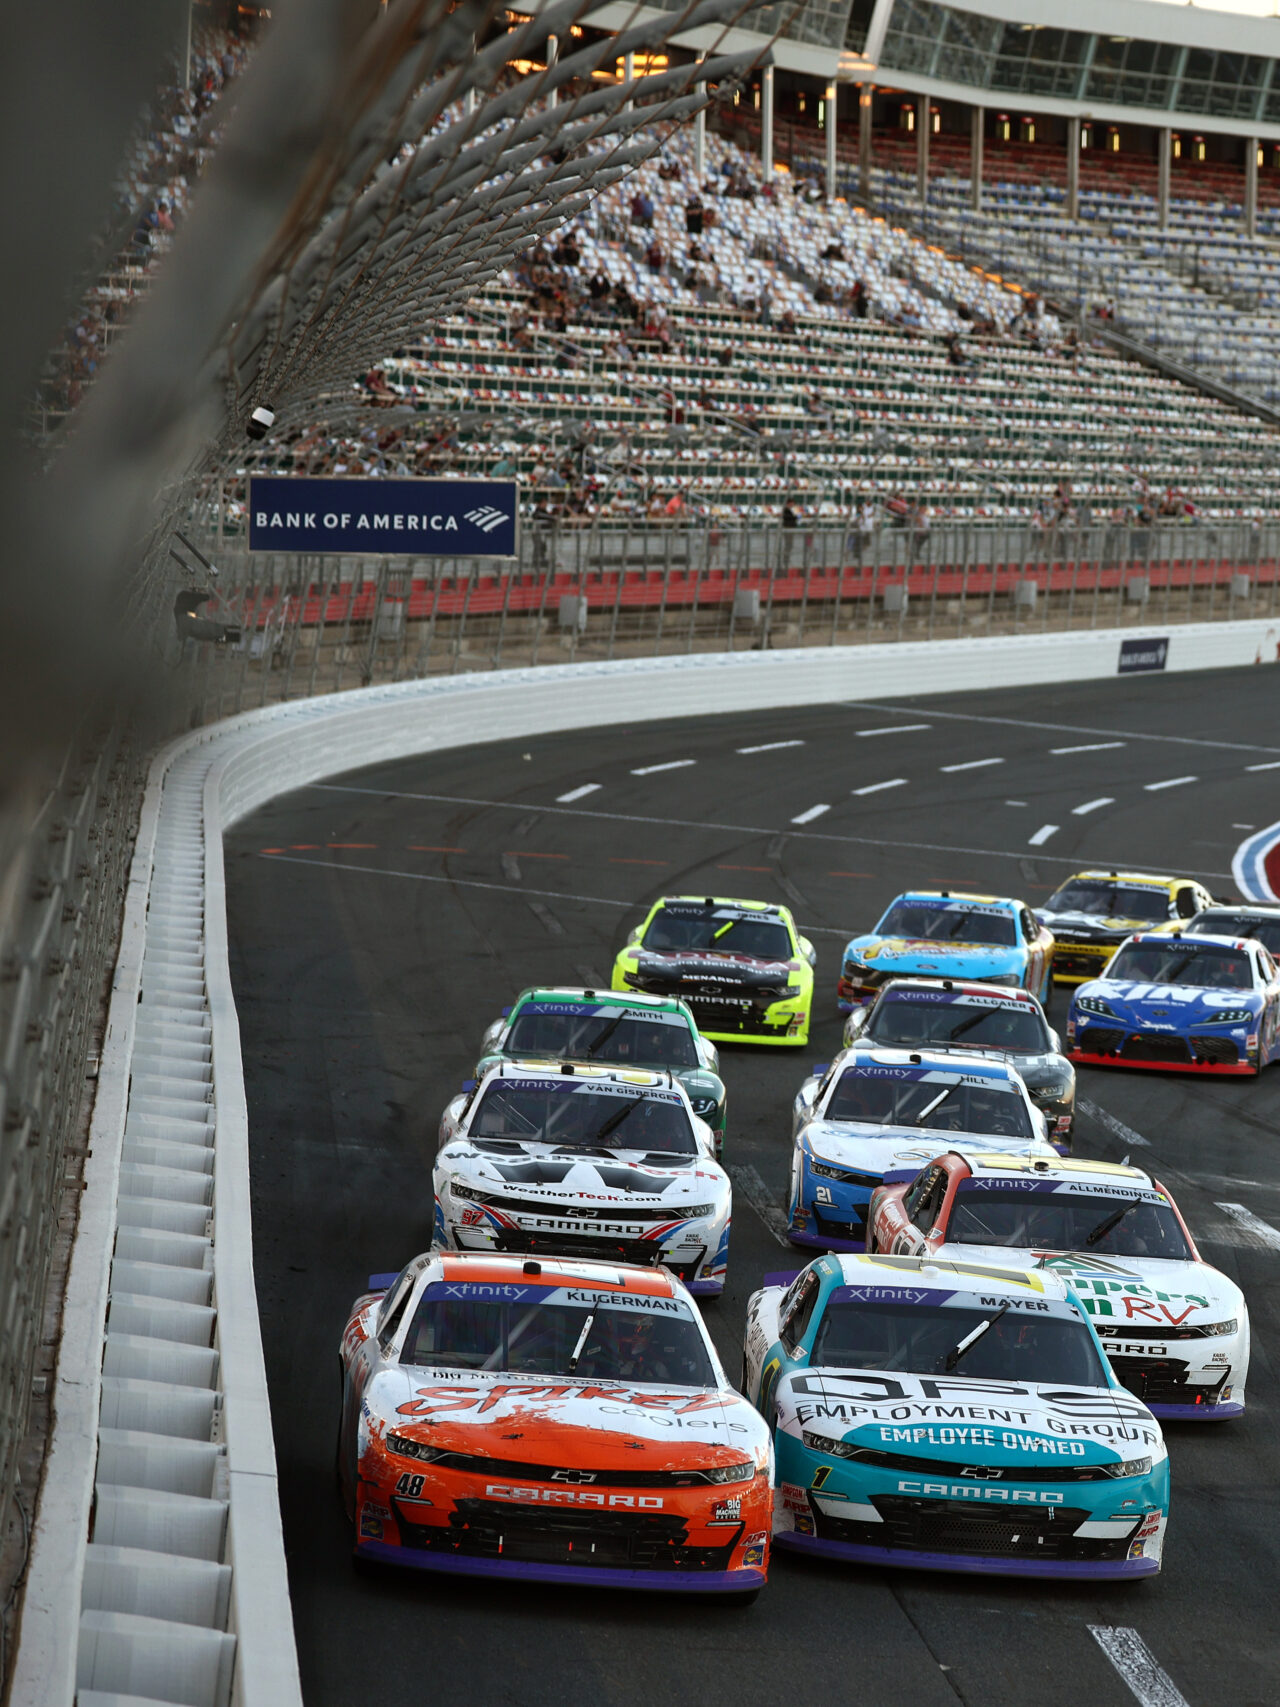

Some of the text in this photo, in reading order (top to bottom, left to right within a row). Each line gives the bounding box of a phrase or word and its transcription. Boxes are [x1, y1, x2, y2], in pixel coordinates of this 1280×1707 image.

[256, 512, 458, 531] BANK OF AMERICA
[959, 904, 1003, 914] CUSTER
[682, 974, 743, 984] MENARDS
[668, 993, 753, 1006] CAMARO
[897, 992, 1027, 1009] xfinity ALLGAIER
[1078, 984, 1252, 1008] KING
[533, 1003, 663, 1020] xfinity SMITH
[855, 1067, 989, 1085] xfinity HILL
[502, 1079, 681, 1103] xfinity VAN GISBERGE
[445, 1152, 719, 1181] WeatherTech
[503, 1184, 662, 1202] WeatherTech.com
[816, 1186, 832, 1203] 21
[974, 1179, 1041, 1192] xfinity
[460, 1209, 485, 1225] 97
[516, 1216, 644, 1234] CAMARO
[444, 1283, 680, 1313] xfinity KLIGERMAN
[849, 1286, 1050, 1312] xfinity MAYER
[1121, 1296, 1199, 1326] RV
[1102, 1343, 1168, 1355] ARO
[395, 1384, 742, 1415] SPIKED
[791, 1374, 1153, 1421] QPS
[598, 1405, 749, 1434] coolers
[797, 1403, 1031, 1426] EMPLOYMENT
[1047, 1416, 1158, 1447] GROUP
[880, 1426, 1085, 1456] EMPLOYEE OWNED
[395, 1472, 426, 1497] 48
[811, 1465, 833, 1489] 1
[485, 1484, 664, 1509] CAMARO
[898, 1481, 1064, 1504] CAMARO
[727, 1500, 741, 1508] BIG
[783, 1498, 811, 1514] ARP
[742, 1531, 767, 1546] ARP
